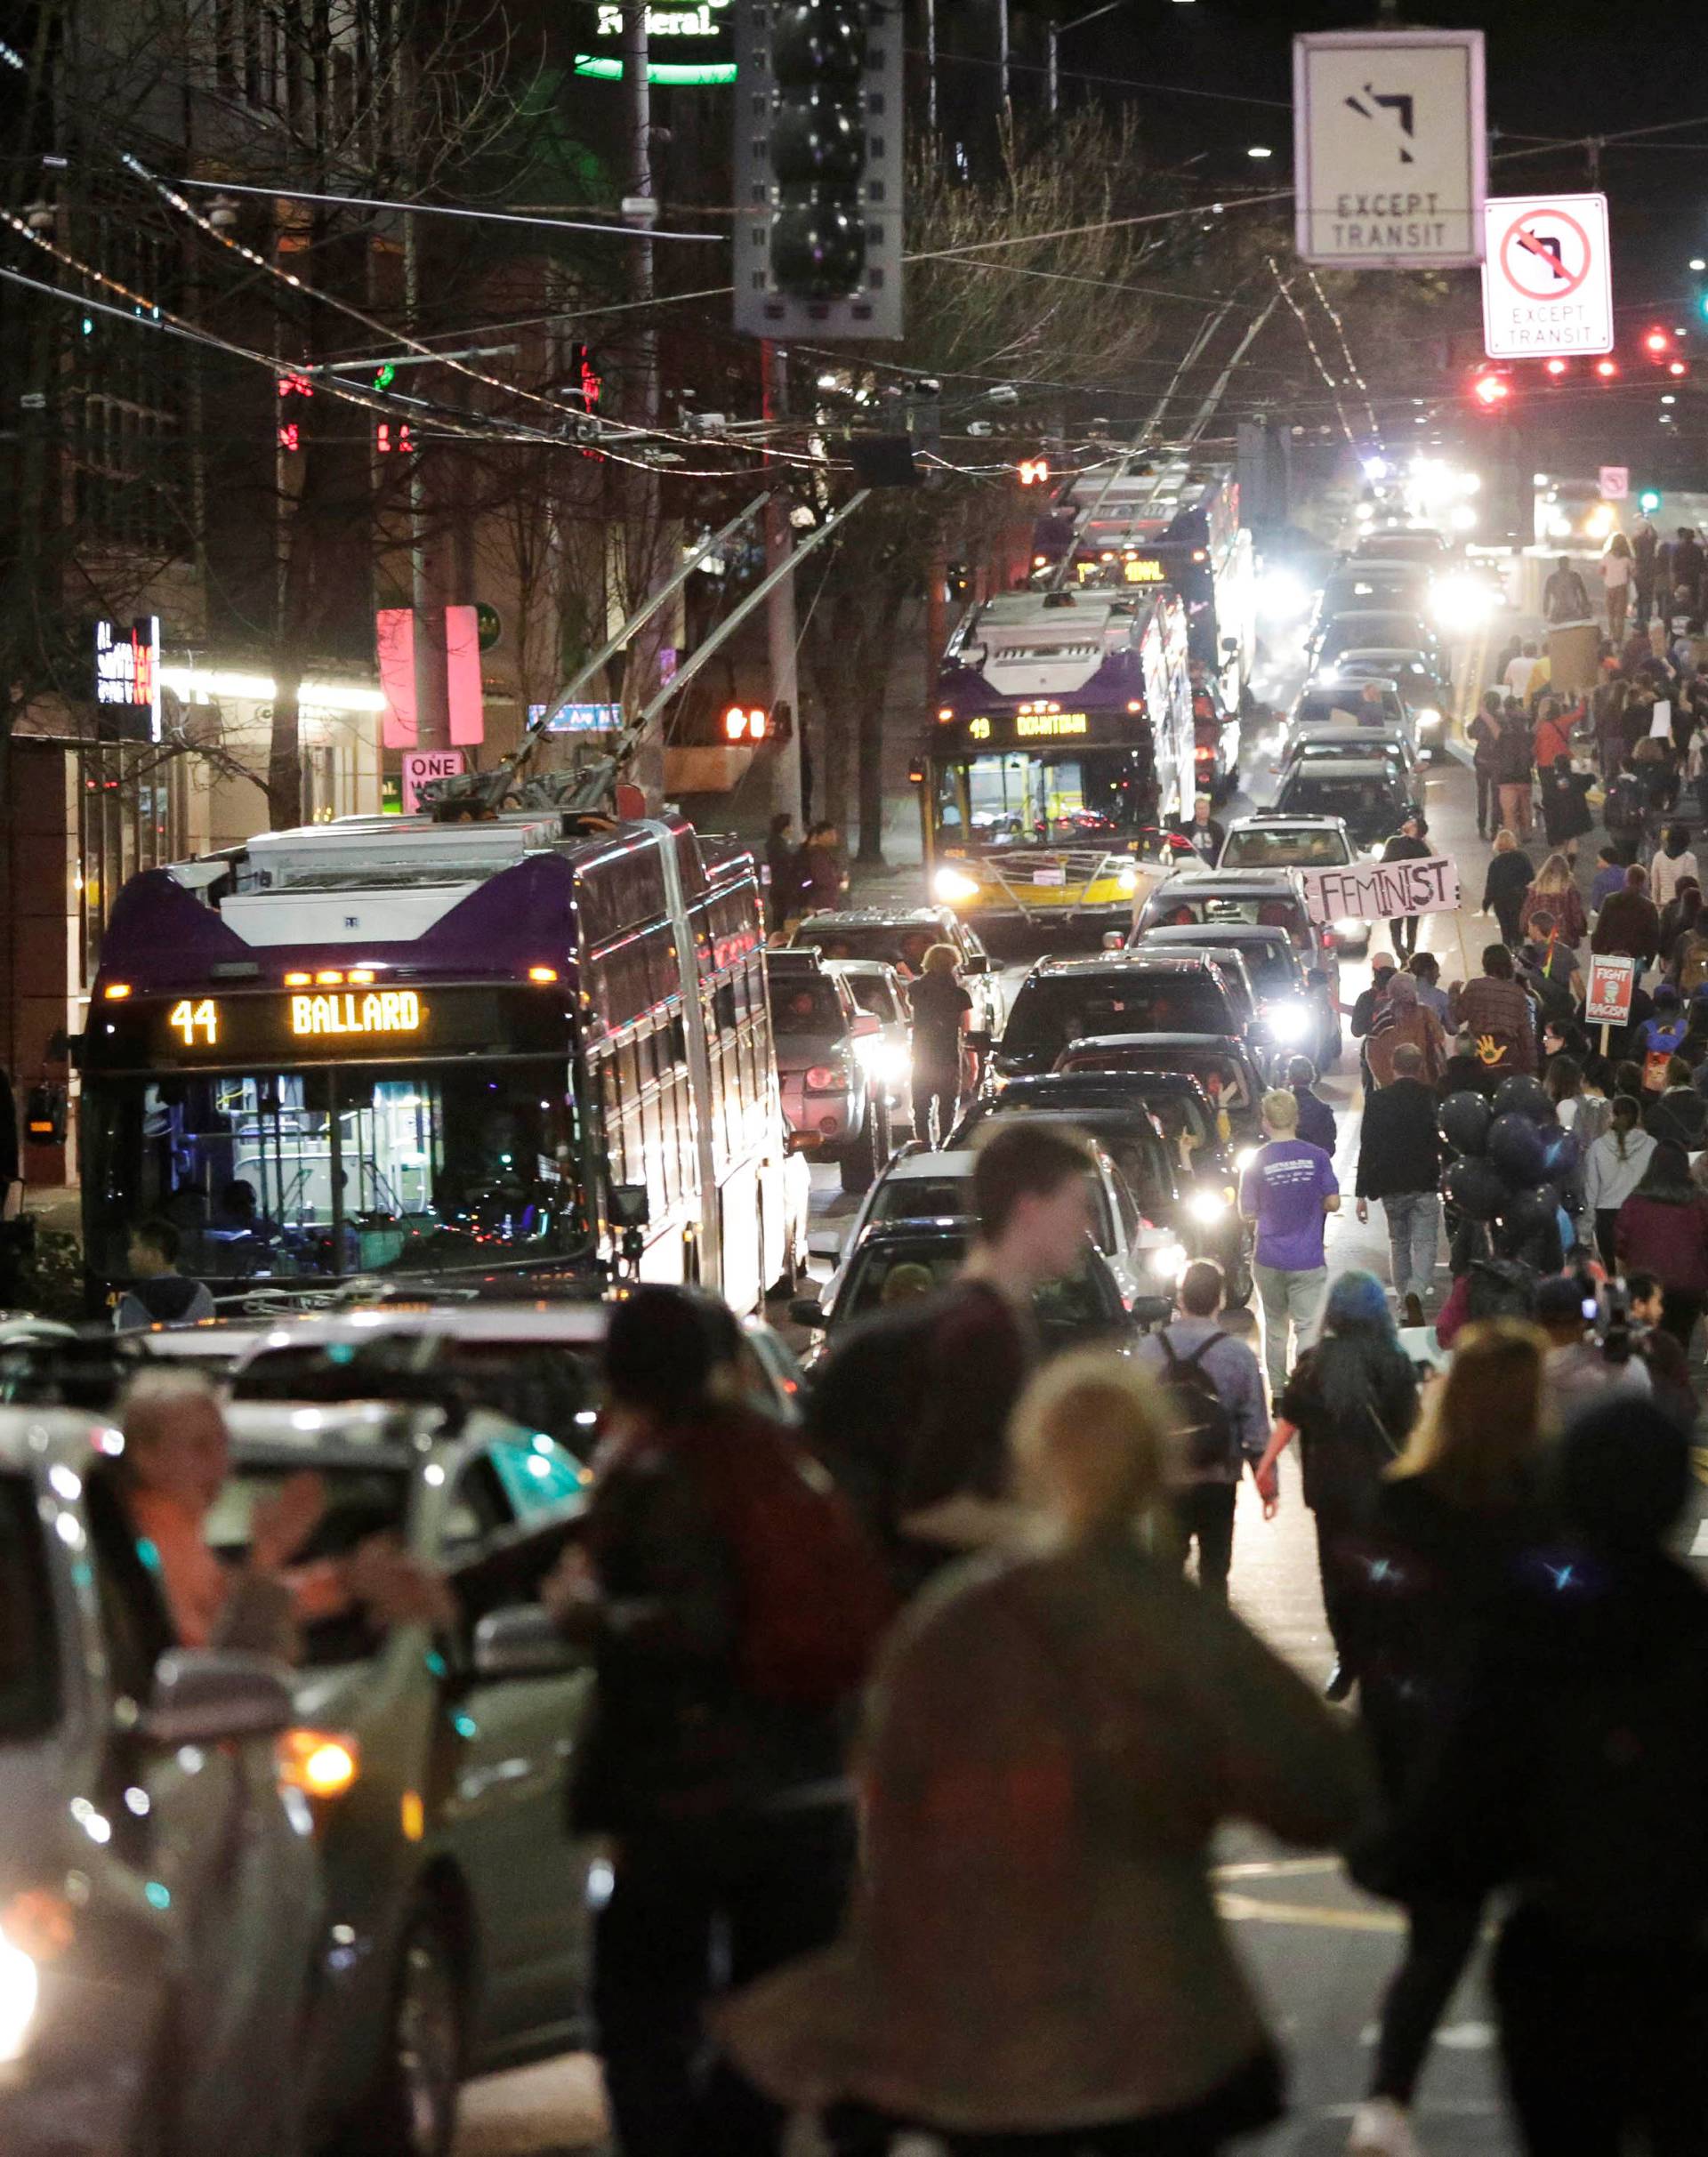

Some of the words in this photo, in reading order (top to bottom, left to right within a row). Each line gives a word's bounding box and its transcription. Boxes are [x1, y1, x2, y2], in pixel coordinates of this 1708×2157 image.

[1337, 192, 1438, 218] EXCEPT
[1332, 223, 1445, 247] TRANSIT
[1511, 304, 1584, 325] EXCEPT
[1509, 326, 1591, 345] TRANSIT
[970, 718, 990, 739] 49
[1017, 713, 1086, 736] DOWNTOWN
[411, 759, 455, 777] ONE
[1319, 860, 1448, 921] FEMINIST
[171, 1000, 216, 1045] 44
[292, 992, 419, 1034] BALLARD
